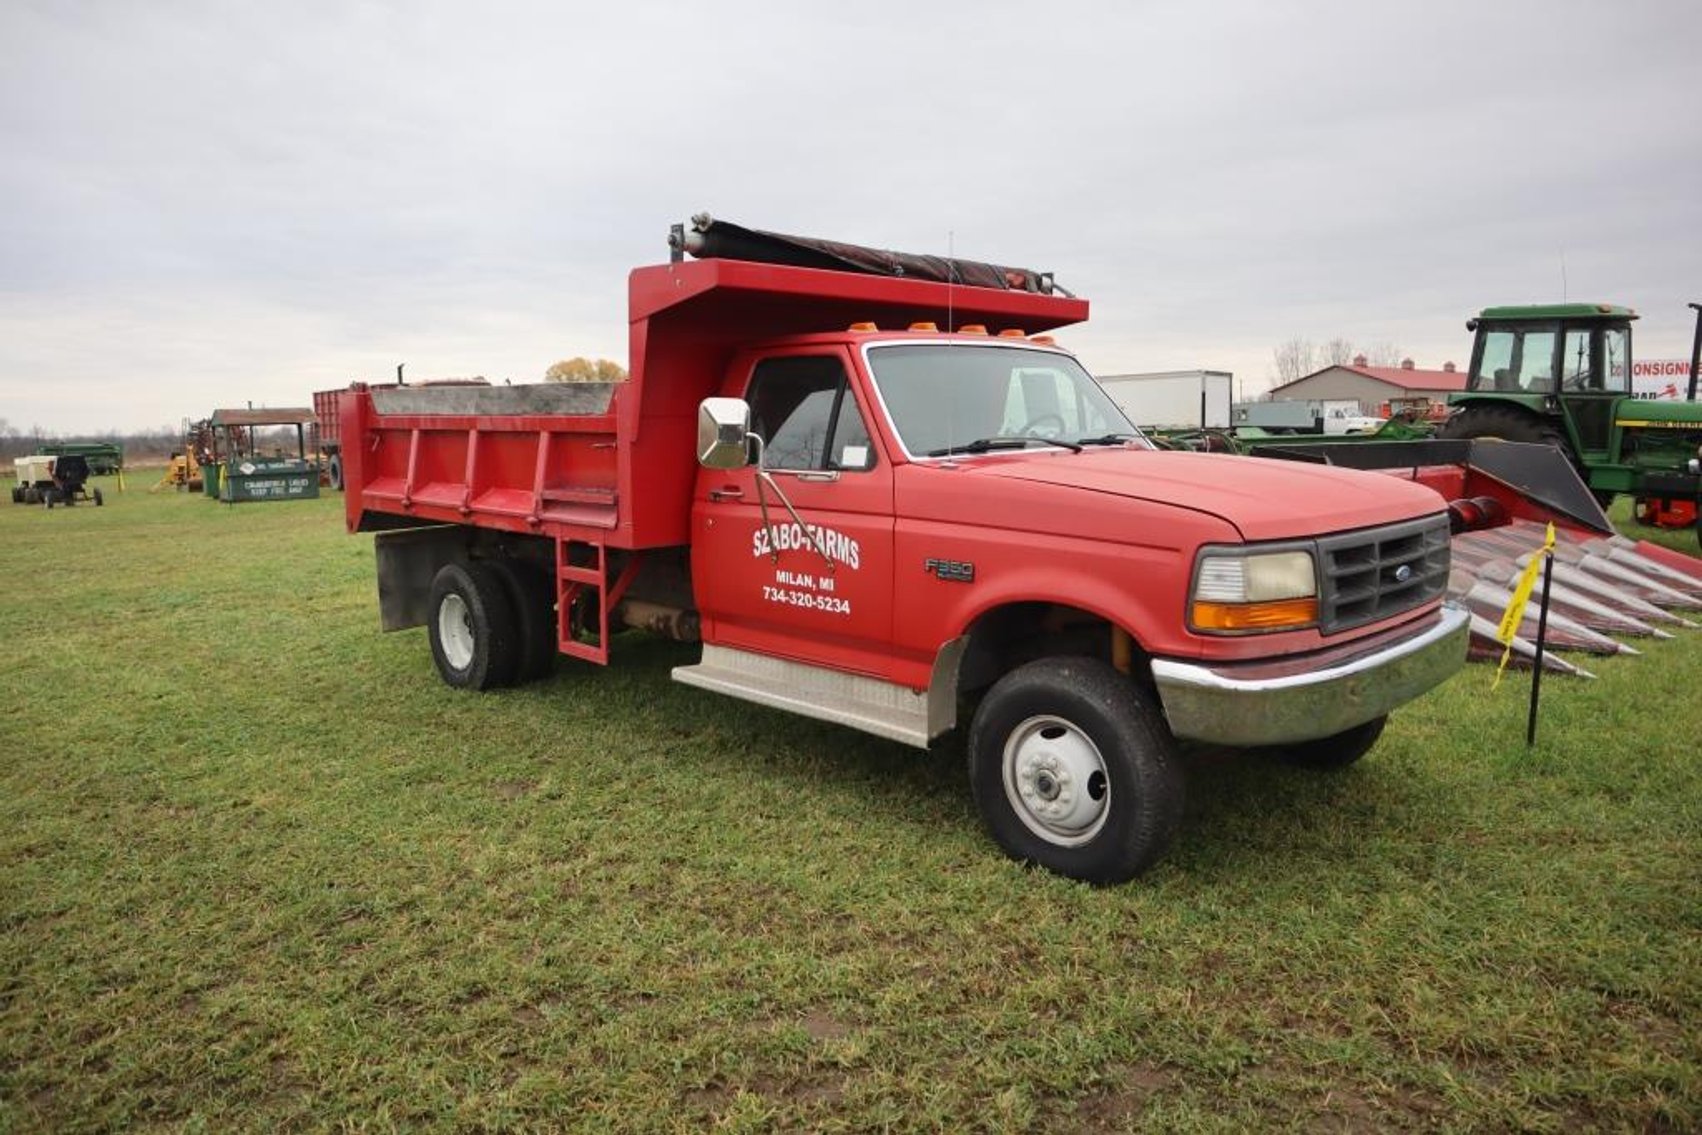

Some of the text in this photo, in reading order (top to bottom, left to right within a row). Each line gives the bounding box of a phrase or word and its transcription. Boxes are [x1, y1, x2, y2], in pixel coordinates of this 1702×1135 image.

[753, 523, 859, 570] SZABO-FARMS
[776, 570, 834, 591] MILAN, MI
[762, 586, 850, 614] 734-320-5234
